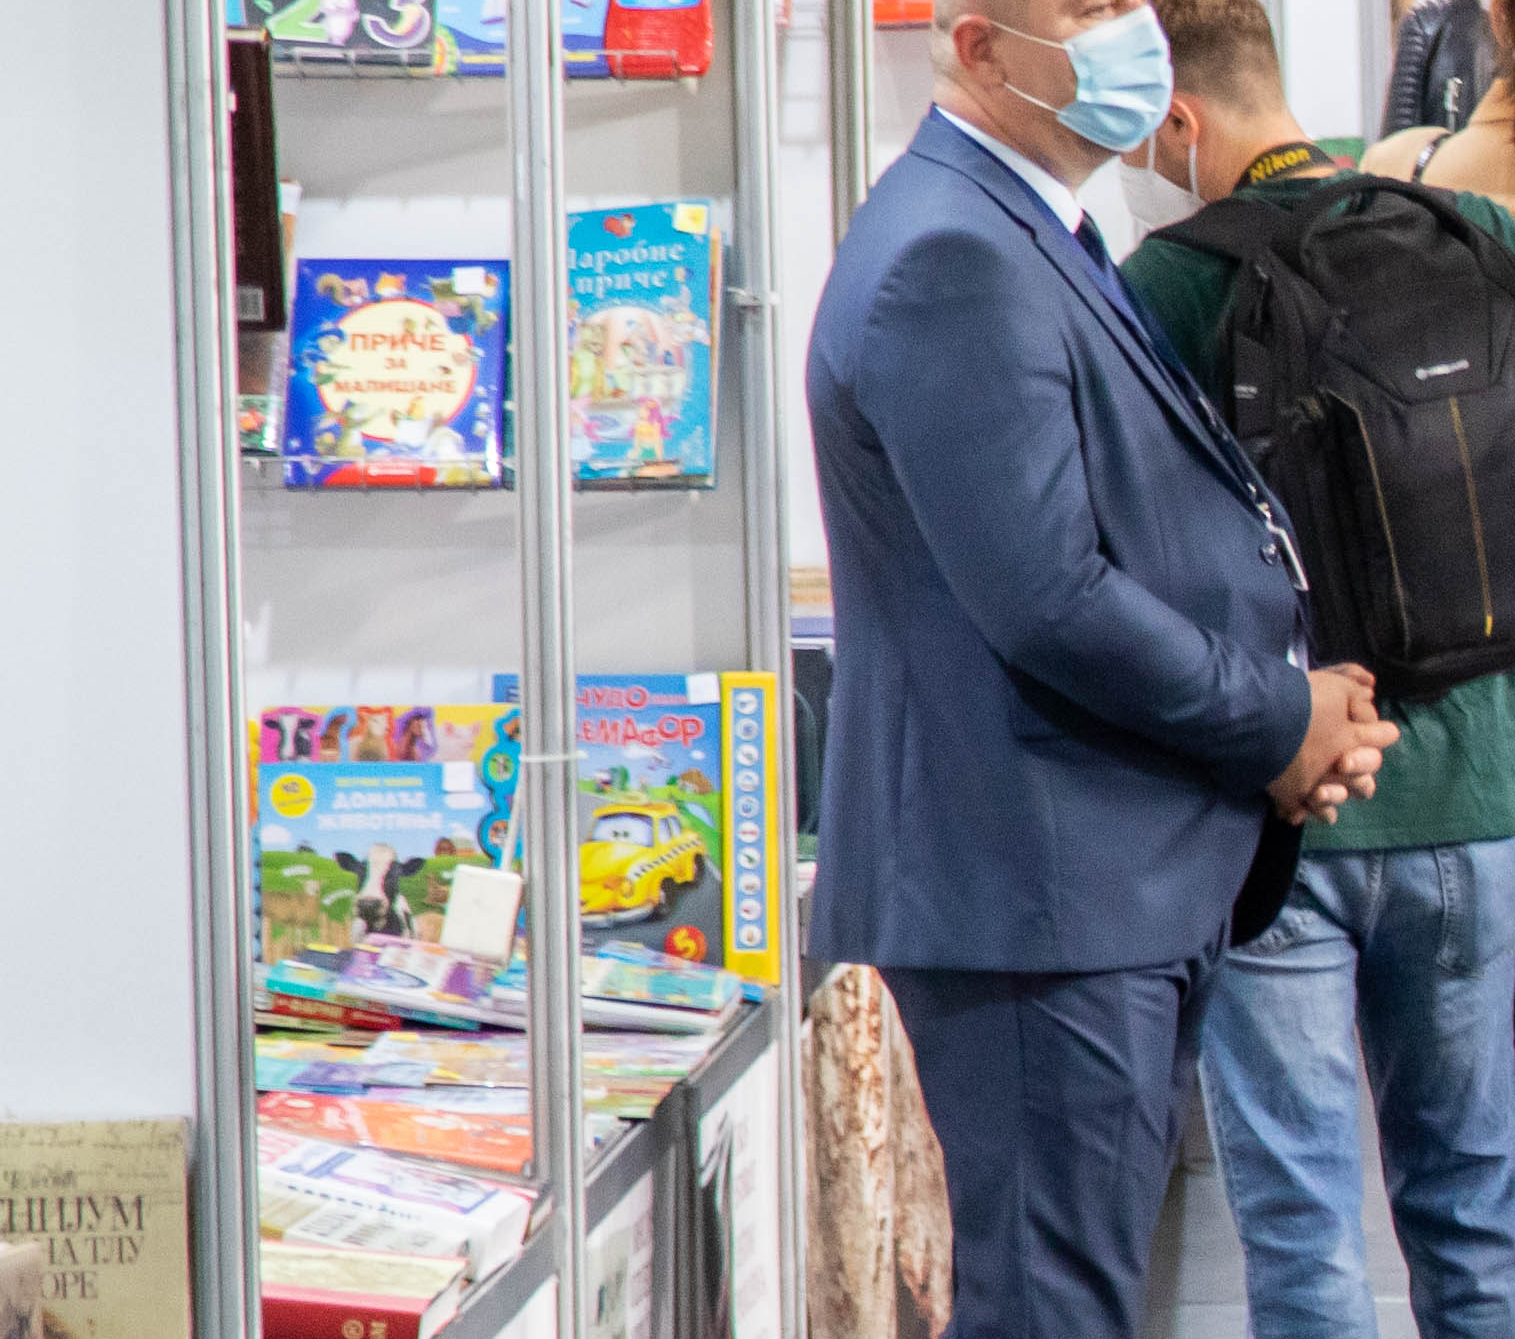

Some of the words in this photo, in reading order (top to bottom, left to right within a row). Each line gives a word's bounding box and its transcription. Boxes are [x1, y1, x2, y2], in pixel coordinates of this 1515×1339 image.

[1249, 147, 1312, 185] Nikon
[349, 333, 446, 352] ПРИЧЕ
[384, 357, 408, 370] ЗА
[333, 379, 457, 394] МАЛИШАНЕ
[576, 714, 705, 748] ЕМАФОР
